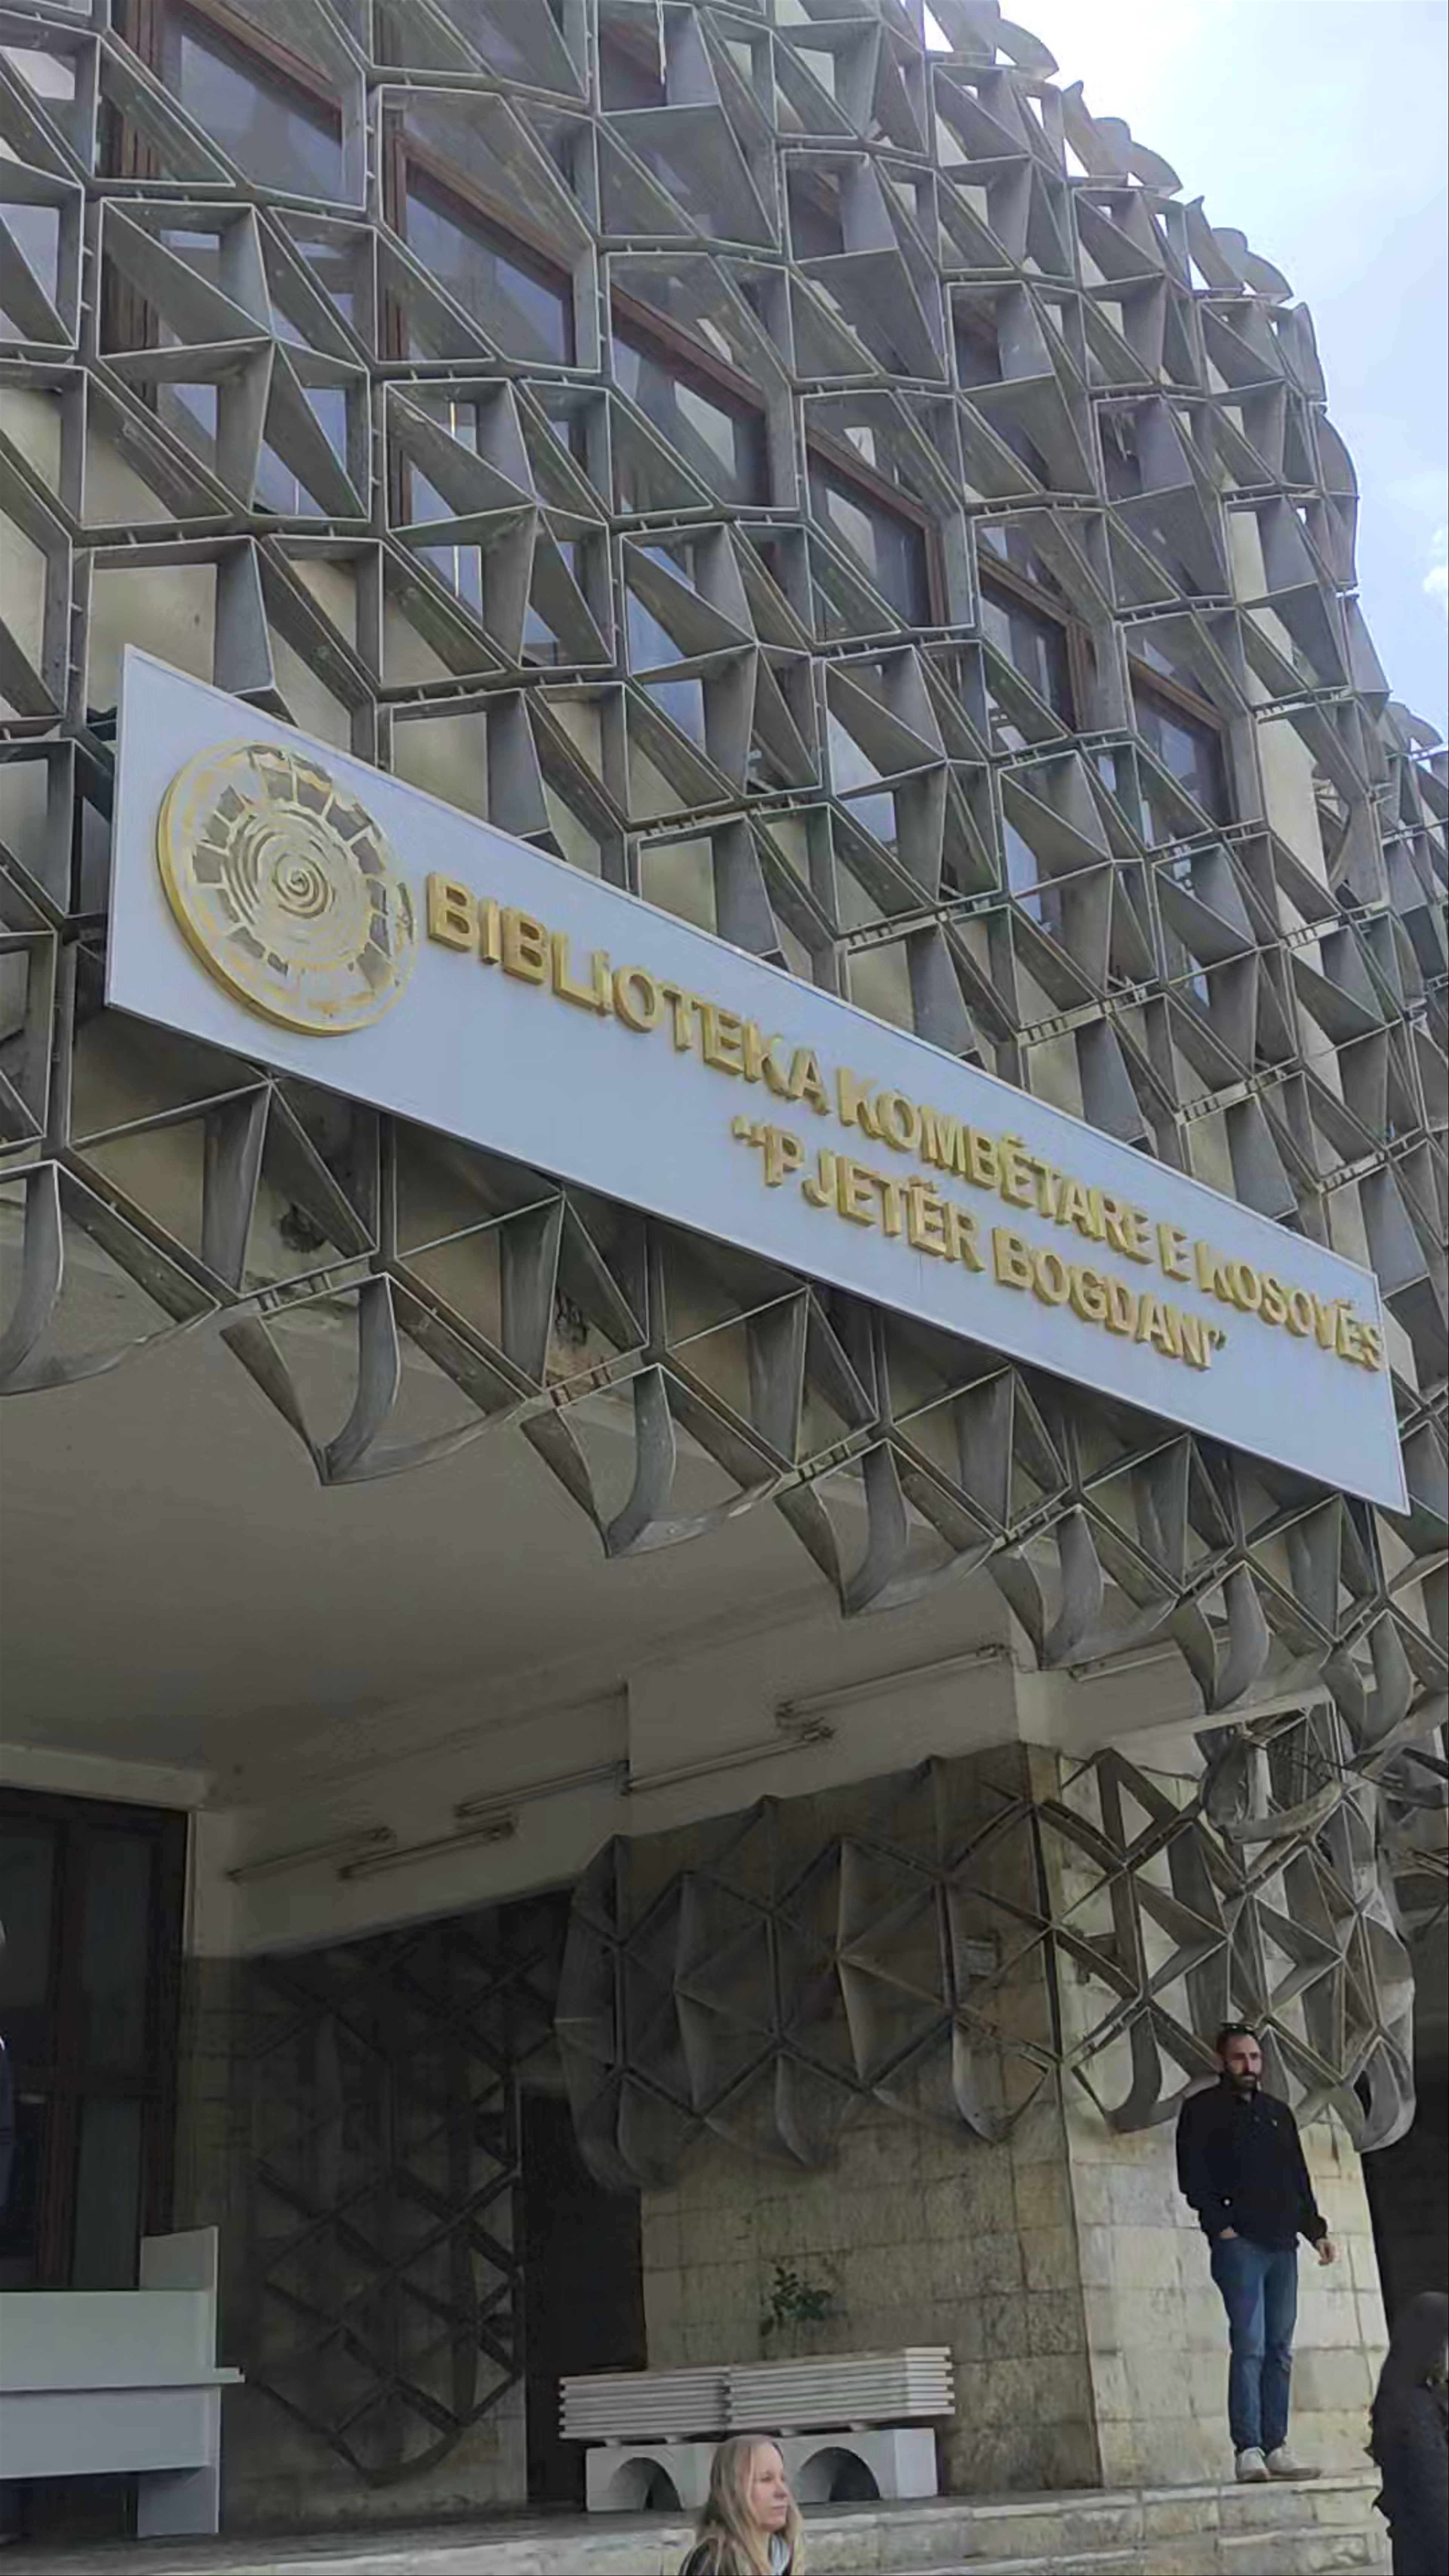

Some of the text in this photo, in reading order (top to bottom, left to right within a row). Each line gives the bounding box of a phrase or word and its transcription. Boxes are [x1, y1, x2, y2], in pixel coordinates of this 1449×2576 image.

[427, 871, 1384, 1372] BIBLIOTEKA KOMBËTARE E KOSOVËS
